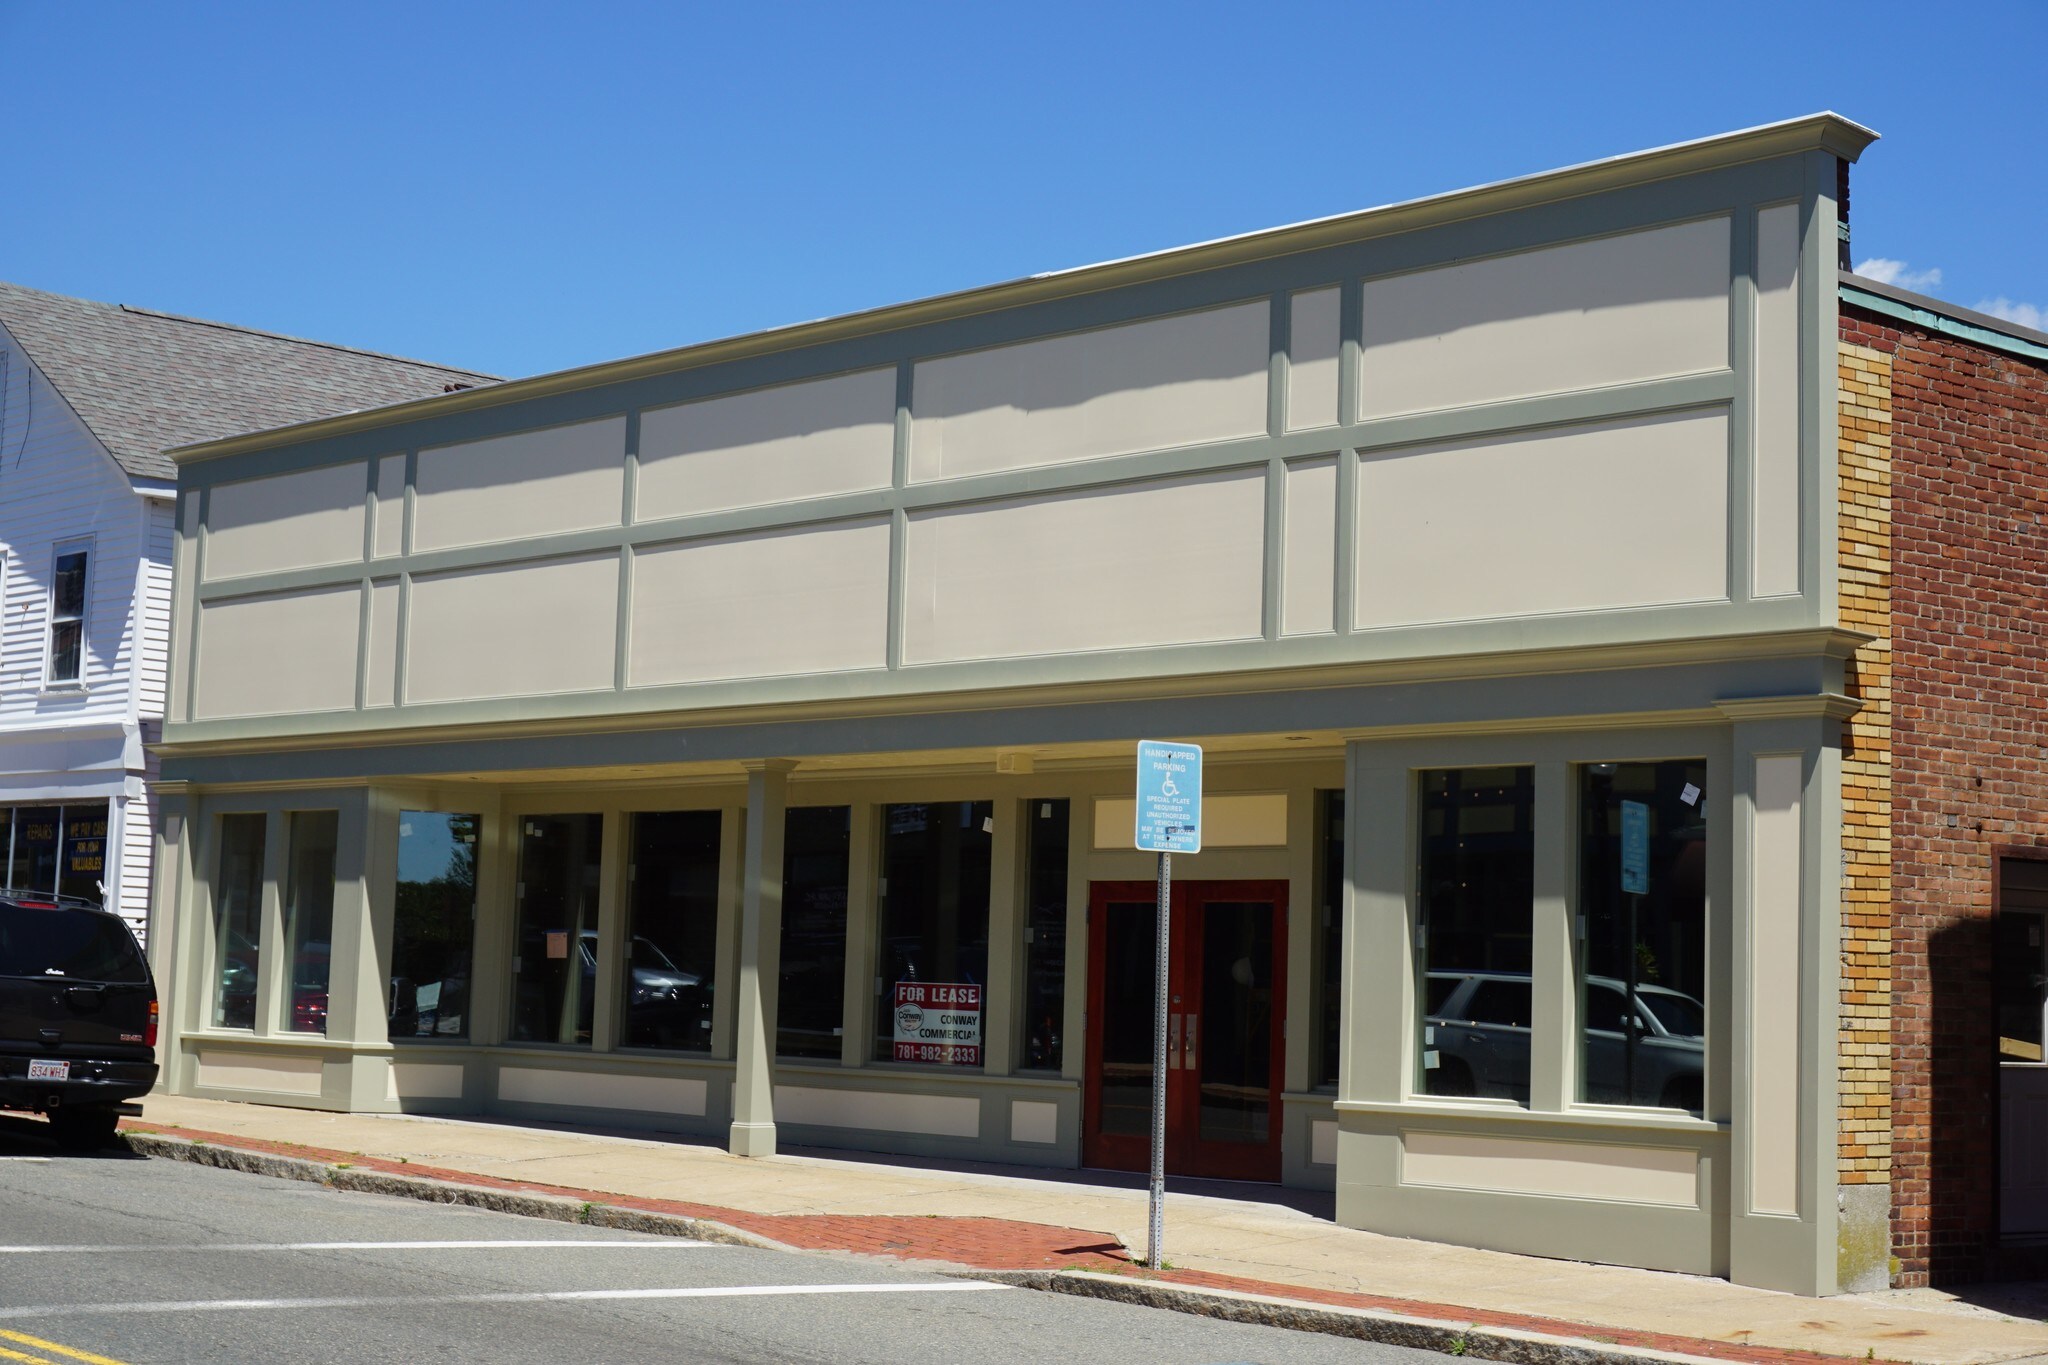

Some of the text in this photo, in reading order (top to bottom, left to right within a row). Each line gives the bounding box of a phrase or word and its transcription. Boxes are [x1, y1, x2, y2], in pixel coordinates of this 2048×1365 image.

[1145, 749, 1196, 760] HANDICAPPED
[1153, 762, 1186, 772] PARKING
[1172, 797, 1190, 805] PLATE
[1147, 812, 1191, 820] UNAUTHORIZED
[27, 823, 53, 839] REPAIRS
[77, 841, 86, 852] FOR
[72, 856, 102, 871] VALUABLES
[899, 986, 978, 1003] FOR LEASE
[898, 1011, 922, 1022] Conway
[940, 1014, 978, 1025] CONWAY
[898, 1044, 976, 1063] 781-982-2333
[31, 1065, 48, 1077] 834
